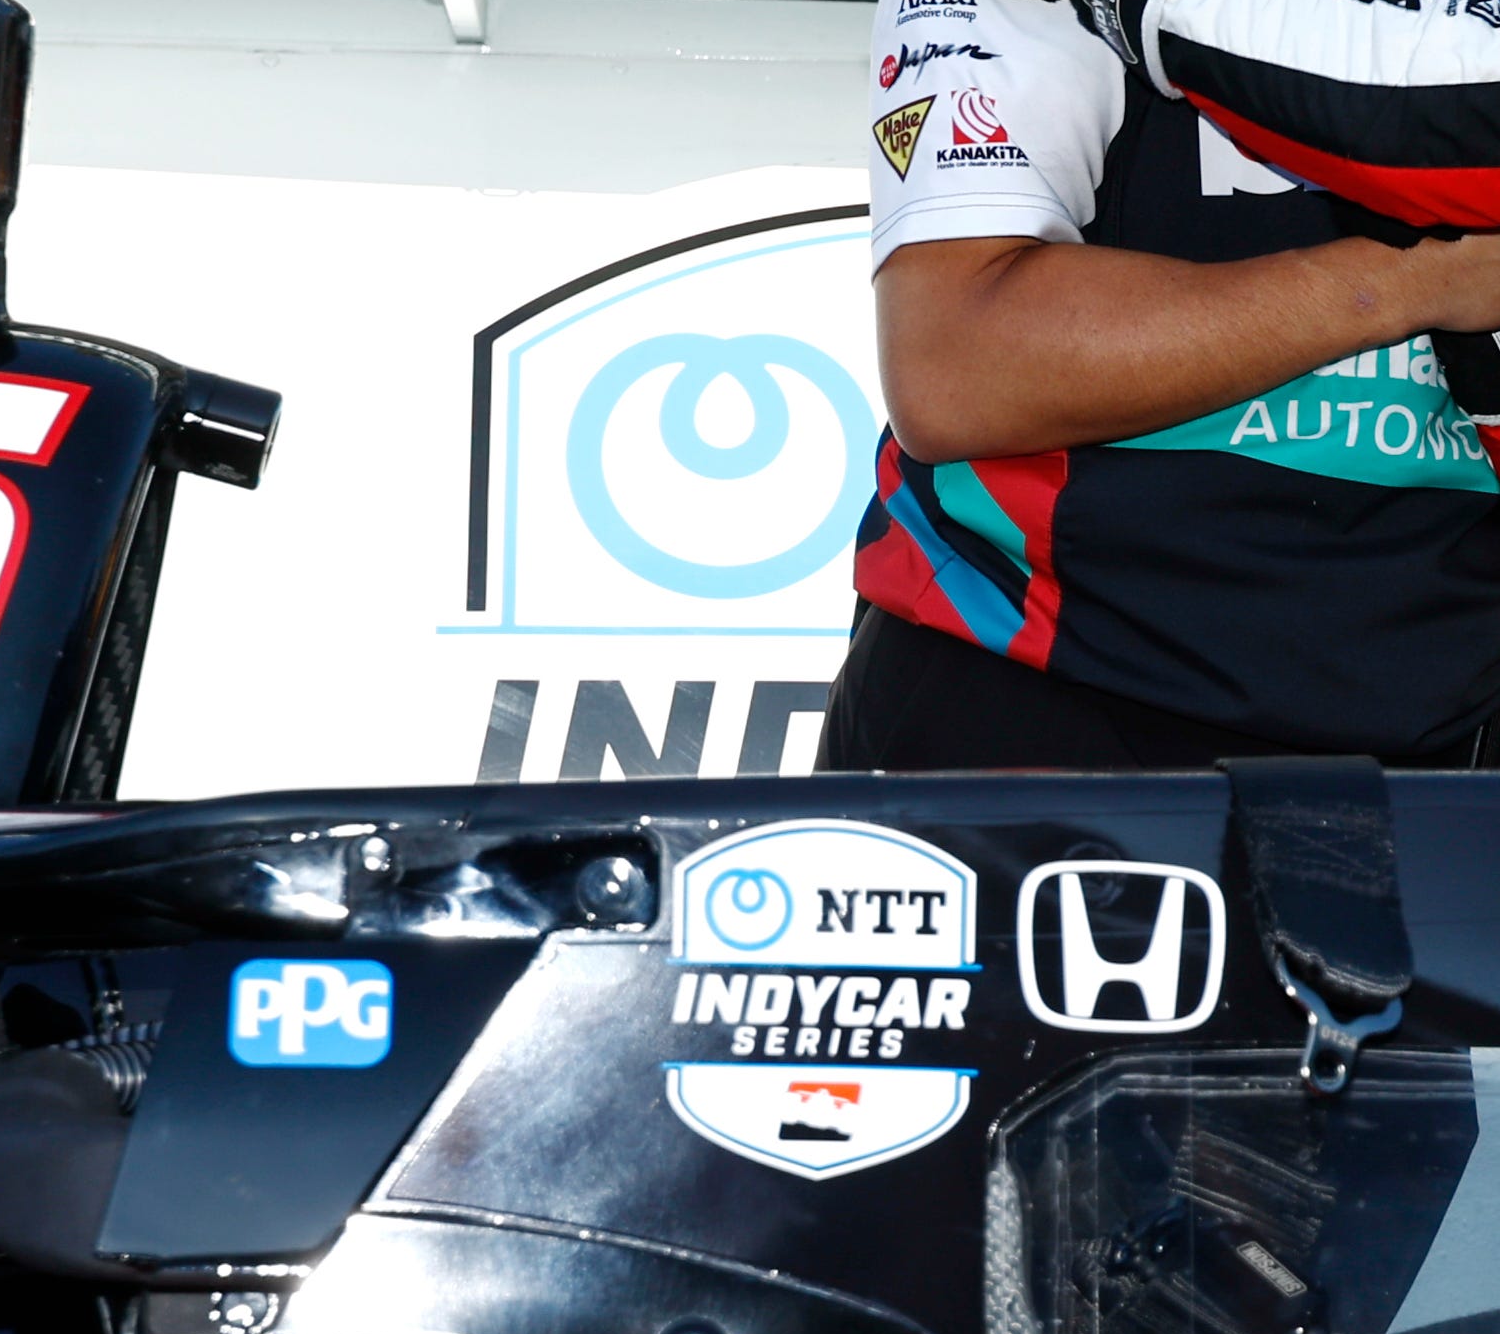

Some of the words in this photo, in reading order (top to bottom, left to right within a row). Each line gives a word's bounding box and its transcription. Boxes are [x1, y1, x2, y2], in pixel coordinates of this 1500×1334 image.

[943, 6, 977, 22] Group
[885, 41, 1003, 92] Japan
[882, 111, 921, 142] Make
[1230, 400, 1488, 465] AUTOMO
[815, 888, 947, 936] NTT
[236, 963, 390, 1056] PPG
[672, 972, 972, 1030] INDYCAR
[731, 1025, 905, 1059] SERIES
